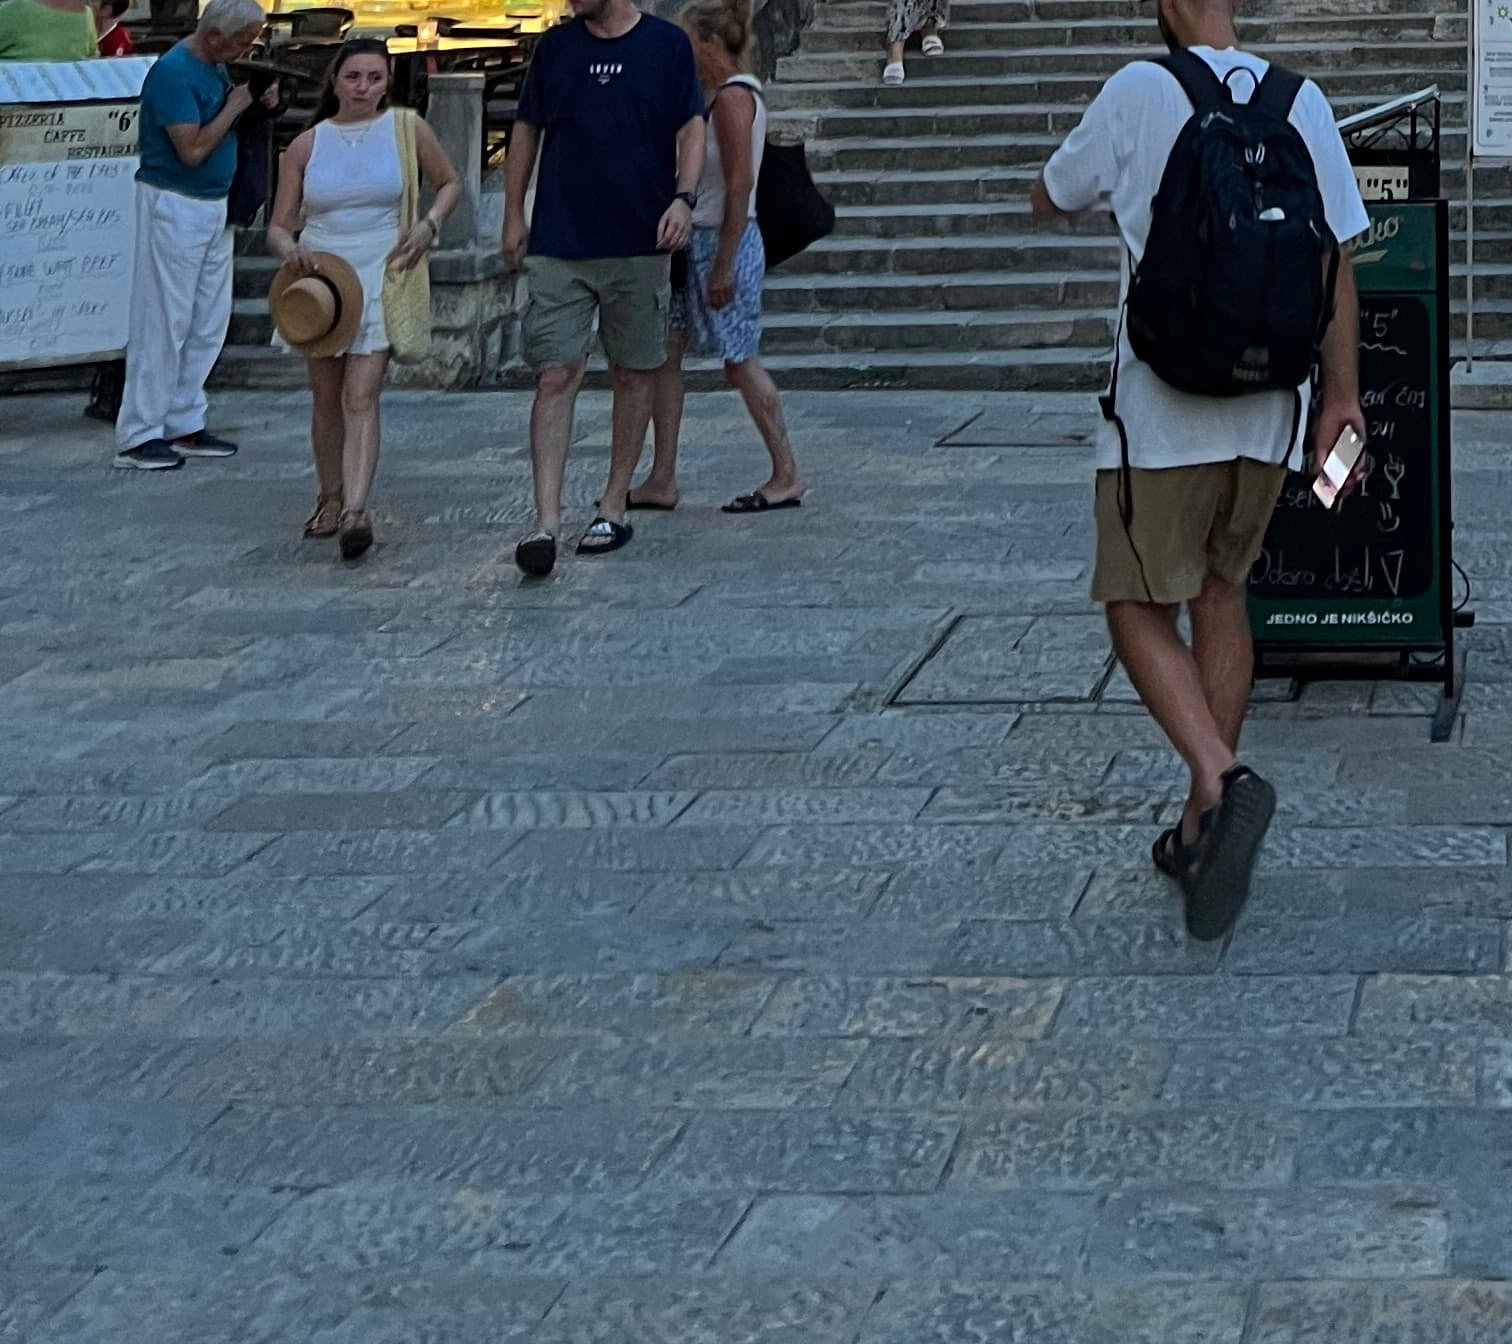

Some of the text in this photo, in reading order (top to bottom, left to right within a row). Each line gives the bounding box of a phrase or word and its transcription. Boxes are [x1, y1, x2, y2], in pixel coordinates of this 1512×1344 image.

[43, 129, 86, 144] CAFFE
[1266, 613, 1317, 625] JEDNO
[1320, 613, 1338, 625] JE
